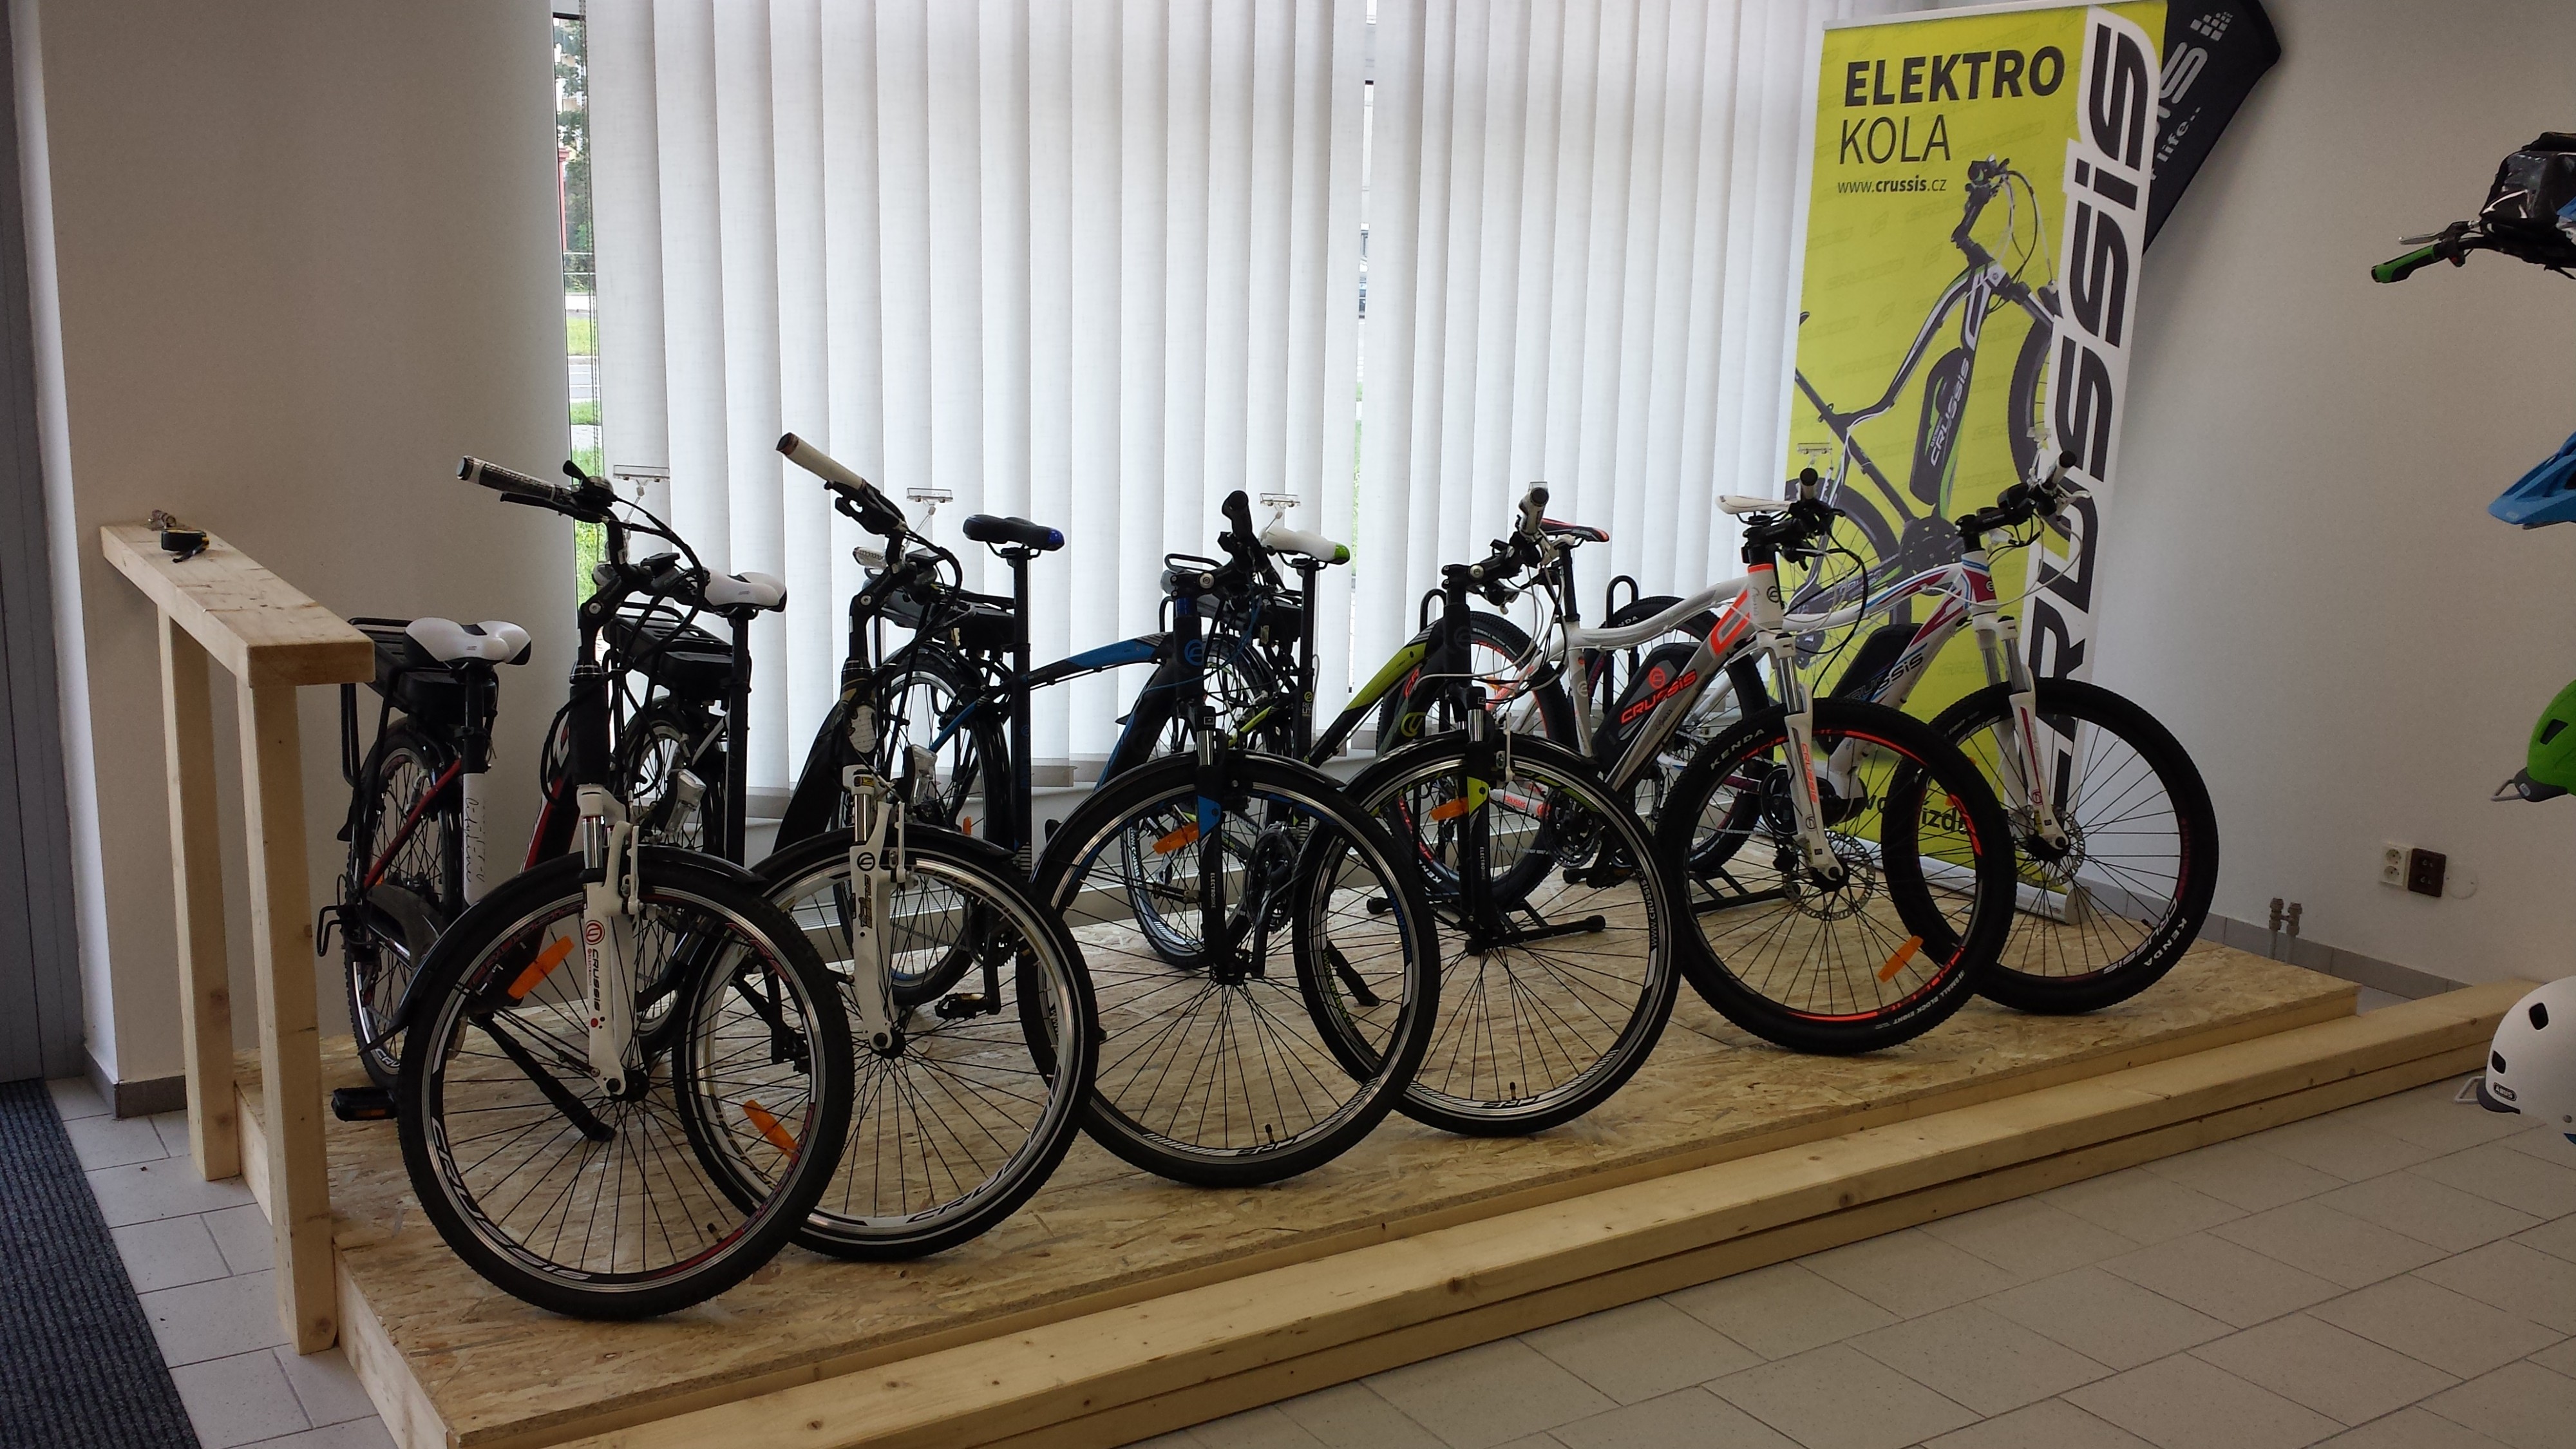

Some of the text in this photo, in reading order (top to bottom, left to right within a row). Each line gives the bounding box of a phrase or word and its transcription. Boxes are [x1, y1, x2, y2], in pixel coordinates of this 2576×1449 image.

[1845, 46, 2065, 107] ELEKTRO
[1839, 115, 1951, 164] KOLA
[1838, 175, 1947, 194] www.crussis.cz
[1620, 668, 1697, 724] CRUSSIS
[1710, 728, 1765, 770] KENDA
[1802, 743, 1817, 802] CRUSSIS
[2102, 896, 2178, 974] CRUSSIS
[2143, 917, 2188, 967] KENDA
[592, 949, 600, 1012] CRUSSIS
[431, 1116, 592, 1281] CRUSSIS
